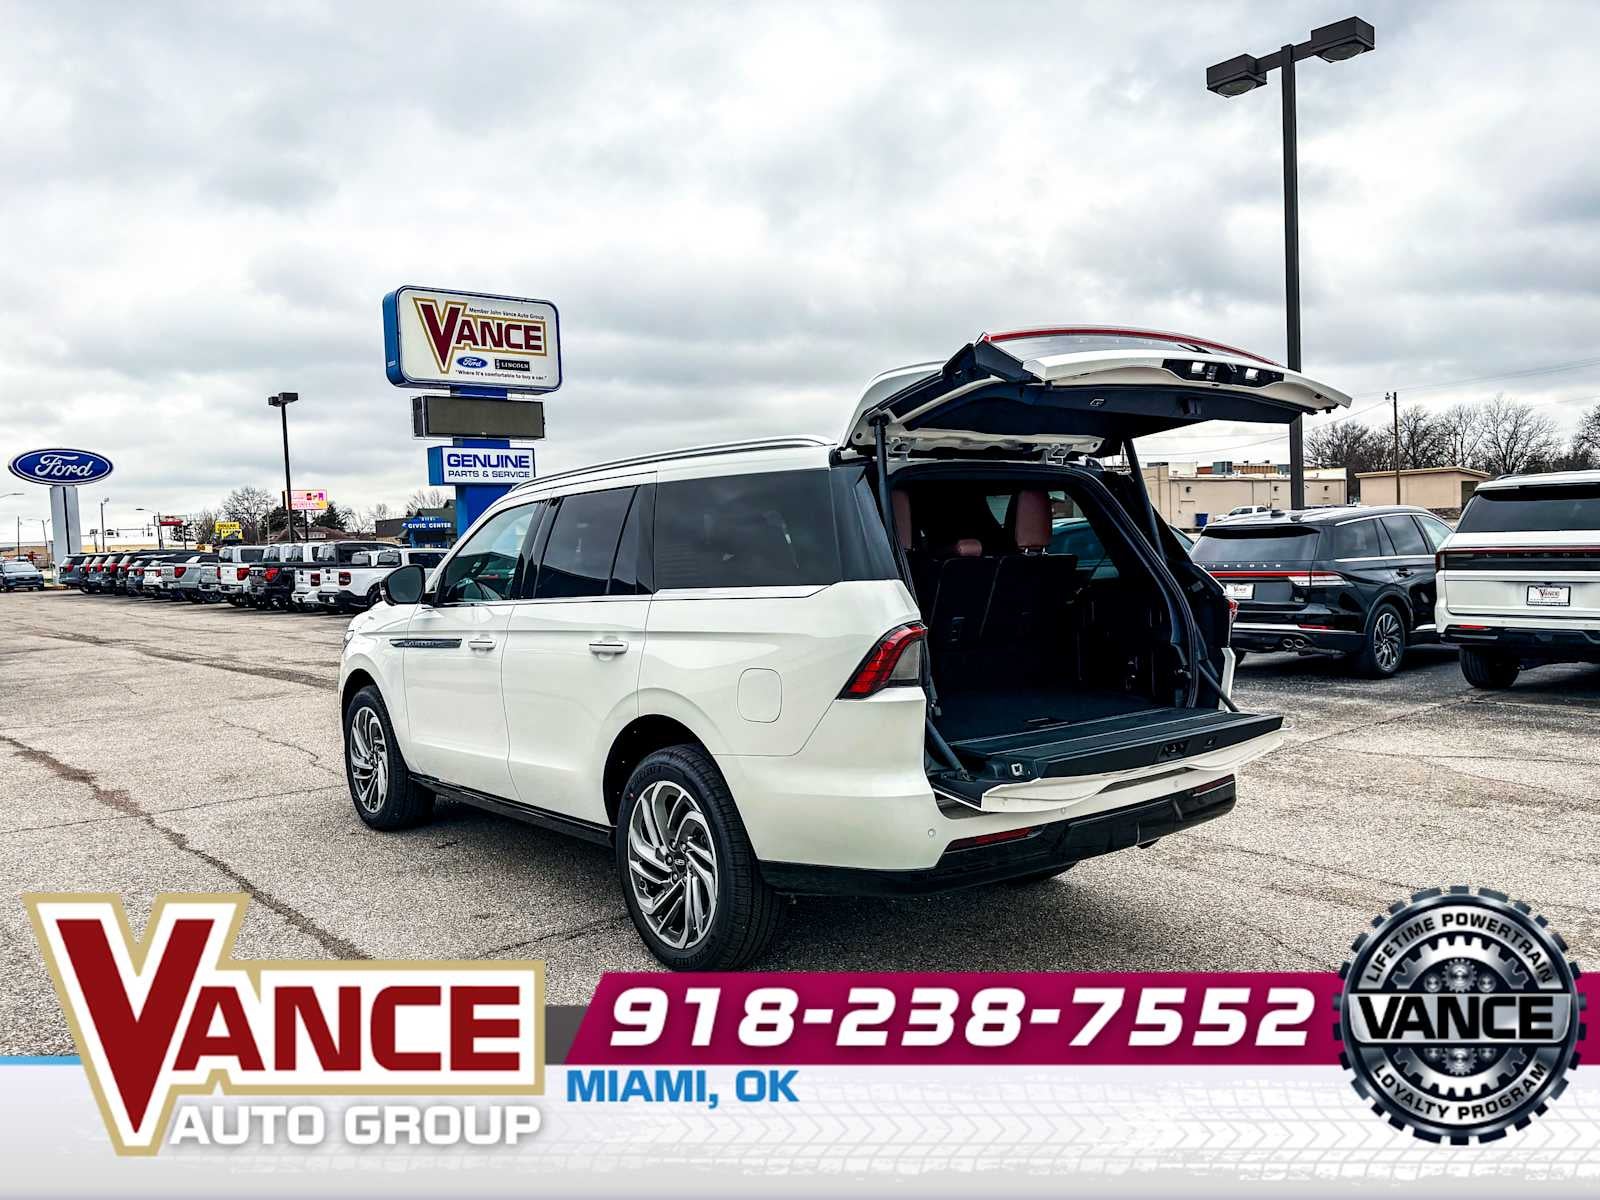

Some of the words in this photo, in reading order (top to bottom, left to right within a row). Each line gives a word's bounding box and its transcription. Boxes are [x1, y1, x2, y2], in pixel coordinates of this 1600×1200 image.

[469, 307, 489, 315] Member
[420, 303, 543, 370] VANCE
[462, 357, 482, 367] Ford
[501, 361, 529, 369] LINCOLN
[34, 453, 95, 477] Ford
[446, 452, 530, 469] GENUINE
[448, 469, 479, 478] PARTS
[492, 470, 530, 479] SERVICE
